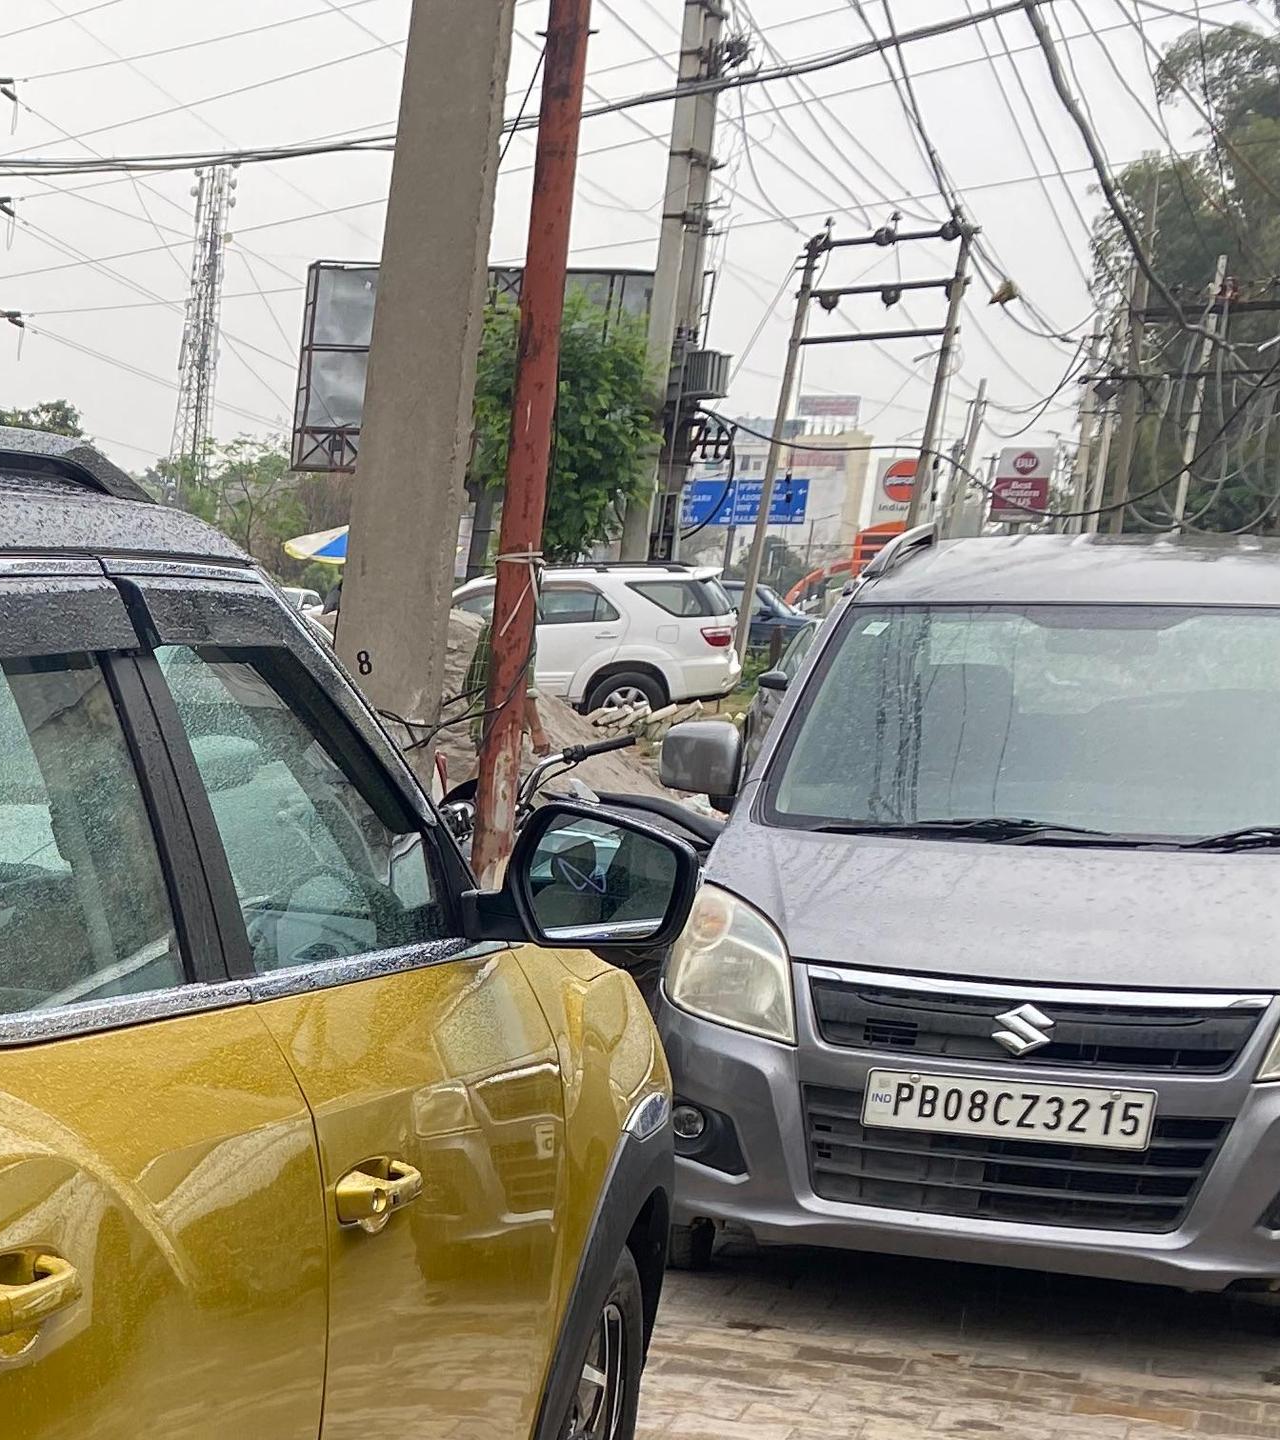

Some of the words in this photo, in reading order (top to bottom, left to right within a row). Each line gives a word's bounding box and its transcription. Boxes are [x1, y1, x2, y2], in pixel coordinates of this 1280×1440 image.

[1011, 481, 1032, 489] Best
[878, 503, 927, 511] Indiail
[357, 650, 372, 675] 8
[871, 1092, 892, 1105] IND
[892, 1082, 1144, 1136] PB08CZ3215
